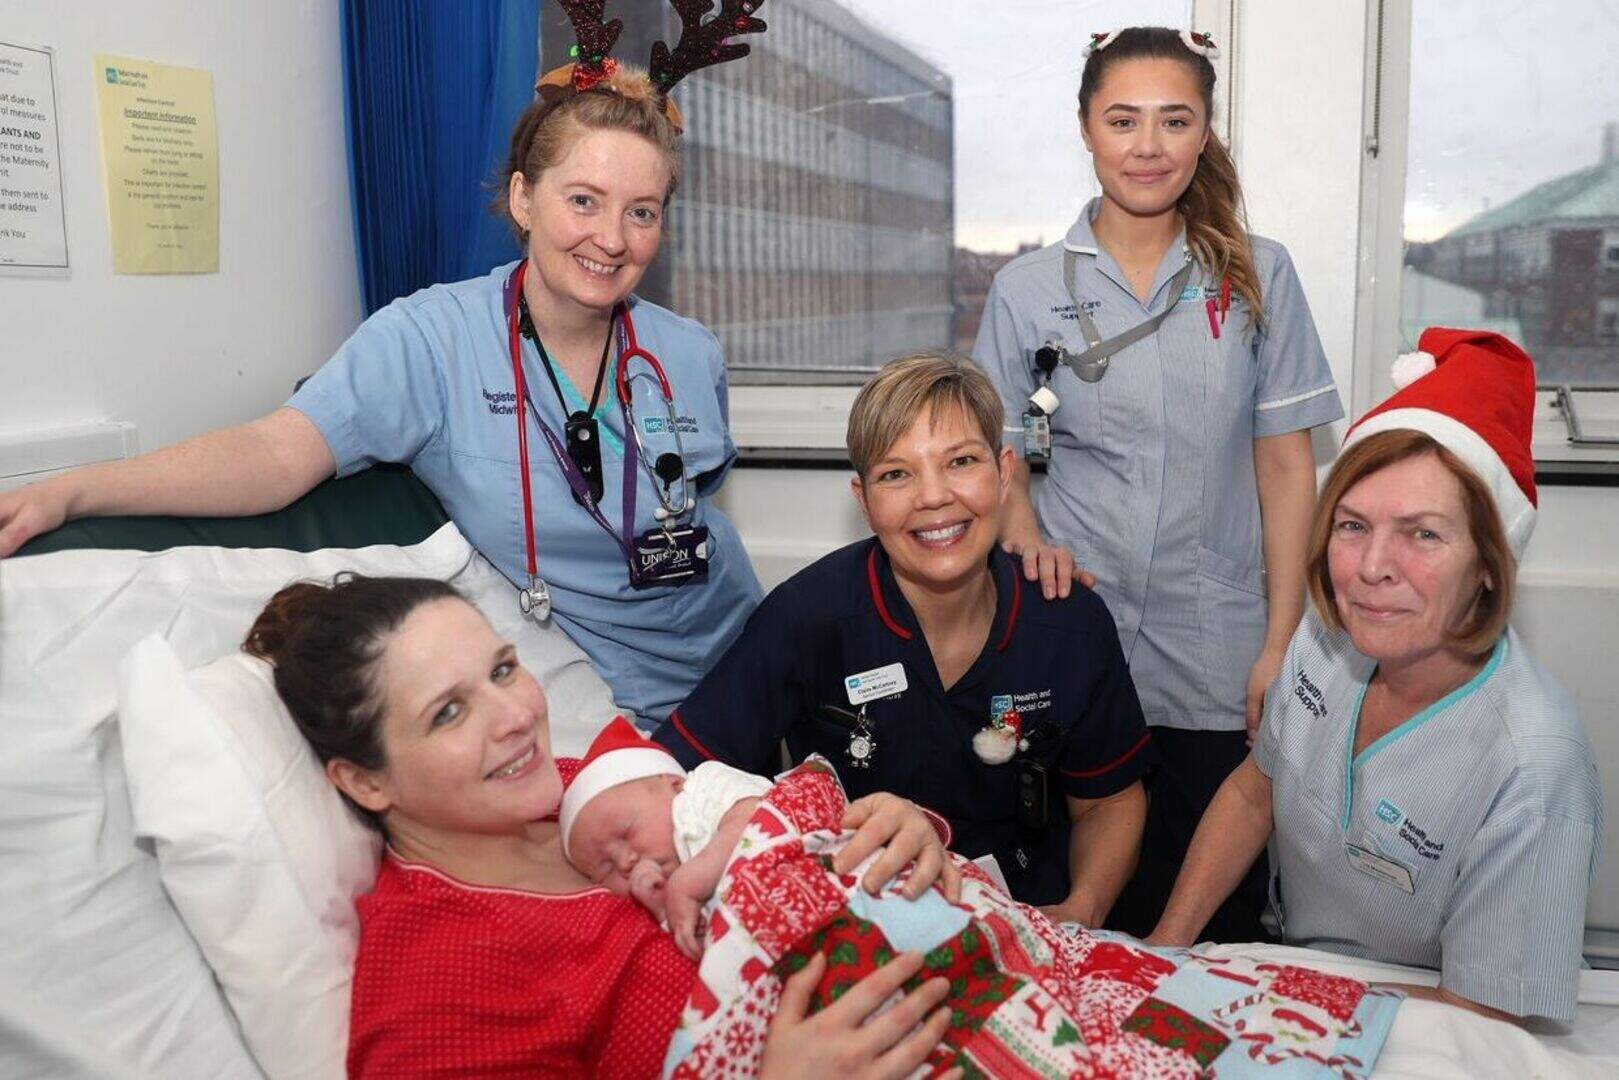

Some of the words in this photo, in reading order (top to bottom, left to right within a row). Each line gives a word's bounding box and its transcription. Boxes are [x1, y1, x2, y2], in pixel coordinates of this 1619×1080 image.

[10, 94, 25, 105] due
[26, 98, 36, 107] to
[10, 109, 46, 121] measures
[124, 107, 159, 121] Important
[23, 129, 42, 141] AND
[10, 143, 23, 152] not
[24, 144, 33, 153] to
[34, 144, 44, 154] be
[12, 156, 49, 171] Maternity
[1, 188, 22, 198] them
[22, 191, 38, 200] sent
[8, 202, 38, 213] address
[11, 229, 26, 239] You
[482, 388, 519, 404] Registe
[1297, 669, 1323, 702] Health
[1013, 692, 1038, 703] Health
[1038, 689, 1052, 699] and
[1015, 702, 1036, 712] Social
[1037, 700, 1052, 710] Care
[1403, 818, 1427, 841] Health
[1424, 839, 1445, 852] and
[1417, 845, 1440, 861] Care
